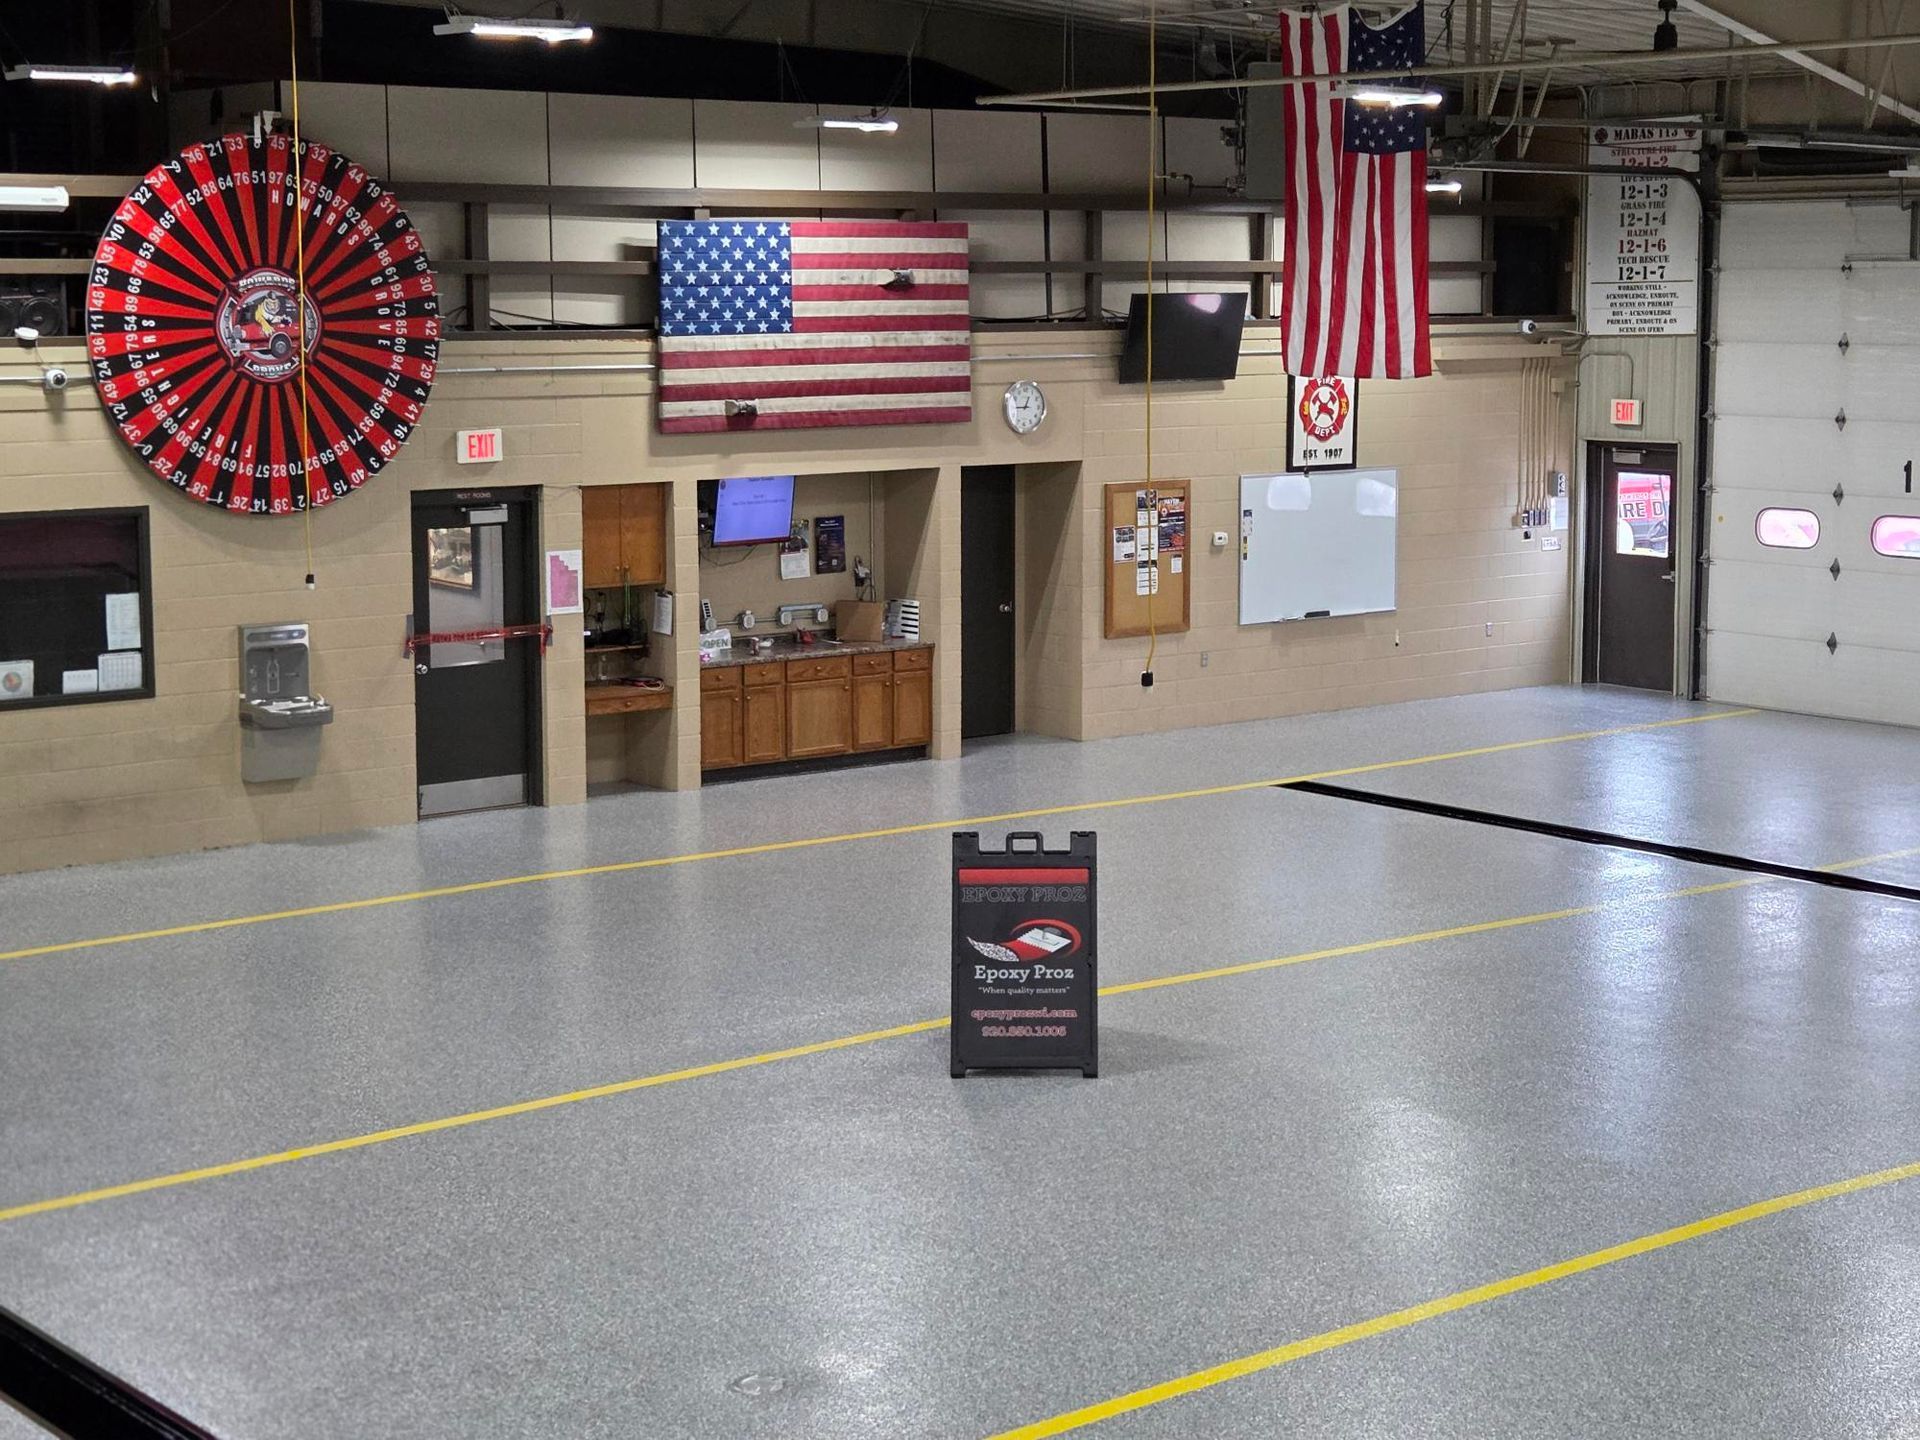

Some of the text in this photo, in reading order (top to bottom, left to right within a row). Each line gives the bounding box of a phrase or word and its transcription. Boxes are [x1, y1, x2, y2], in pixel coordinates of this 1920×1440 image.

[1614, 128, 1678, 140] MABAS 113
[209, 140, 223, 157] 21
[230, 137, 244, 150] 33
[271, 137, 285, 150] 45
[312, 147, 326, 162] 32
[335, 157, 343, 169] 7
[150, 170, 168, 188] 34
[218, 175, 234, 190] 64
[234, 172, 250, 186] 76
[252, 171, 266, 184] 51
[269, 172, 283, 184] 97
[348, 168, 364, 184] 44
[201, 181, 218, 197] 88
[302, 179, 318, 194] 75
[318, 186, 332, 202] 50
[368, 183, 380, 198] 19
[1621, 184, 1668, 200] 12-1-3
[134, 186, 152, 205] 22
[186, 189, 203, 206] 52
[332, 196, 348, 210] 87
[122, 204, 137, 222] 47
[170, 199, 187, 217] 77
[380, 197, 396, 214] 31
[1620, 201, 1666, 210] GRASS FIRE
[160, 211, 176, 229] 65
[346, 206, 361, 224] 62
[1620, 212, 1666, 227] 12-1-4
[110, 224, 126, 240] 10
[148, 226, 165, 244] 98
[358, 220, 374, 236] 96
[1627, 228, 1658, 237] HAZMAT
[368, 233, 384, 250] 74
[406, 236, 418, 250] 43
[1620, 238, 1666, 254] 12-1-6
[100, 244, 116, 261] 35
[138, 242, 155, 259] 53
[378, 250, 392, 266] 86
[414, 256, 428, 270] 18
[1618, 255, 1670, 264] TECH RESCUE
[131, 259, 148, 276] 78
[386, 266, 400, 282] 61
[1618, 266, 1666, 280] 12-1-7
[95, 267, 109, 284] 23
[391, 284, 404, 300] 95
[420, 277, 432, 292] 30
[92, 291, 105, 306] 48
[125, 296, 138, 312] 89
[371, 276, 392, 346] GROVE
[394, 301, 406, 317] 73
[90, 316, 104, 330] 11
[124, 316, 138, 330] 54
[396, 320, 408, 334] 85
[426, 321, 437, 336] 42
[92, 338, 106, 353] 36
[125, 334, 139, 350] 79
[394, 337, 406, 353] 60
[424, 344, 436, 358] 17
[97, 360, 112, 376] 24
[391, 355, 404, 370] 94
[420, 364, 432, 378] 29
[385, 372, 400, 388] 72
[1317, 376, 1336, 386] FIRE
[104, 384, 118, 398] 49
[142, 388, 157, 404] 55
[378, 388, 392, 404] 84
[414, 388, 426, 396] 4
[113, 403, 128, 420] 12
[152, 403, 168, 420] 80
[370, 402, 384, 419] 59
[404, 404, 418, 420] 41
[1616, 402, 1634, 421] EXIT
[360, 416, 374, 432] 93
[394, 424, 408, 439] 16
[1315, 426, 1335, 436] DEPT
[124, 426, 140, 440] 37
[176, 430, 192, 447] 90
[348, 429, 364, 446] 71
[142, 444, 152, 456] 0
[190, 441, 206, 458] 56
[334, 440, 349, 456] 83
[381, 439, 396, 456] 28
[468, 434, 496, 458] EXIT
[1324, 448, 1342, 458] 1907
[205, 450, 220, 466] 81
[320, 449, 334, 464] 58
[370, 458, 380, 468] 3
[155, 458, 172, 474] 25
[256, 464, 270, 478] 57
[272, 464, 286, 478] 82
[289, 462, 304, 475] 70
[173, 470, 188, 486] 13
[351, 469, 364, 484] 40
[1904, 460, 1912, 493] 1
[192, 482, 208, 497] 38
[334, 480, 348, 494] 15
[234, 496, 248, 510] 26
[297, 495, 306, 508] 2
[316, 488, 330, 503] 27
[254, 498, 268, 511] 14
[274, 498, 288, 510] 39
[702, 638, 728, 649] OPEN
[962, 886, 1087, 902] EPOXY PROZ
[974, 964, 1074, 983] Epoxy Proz
[1007, 986, 1034, 995] quality
